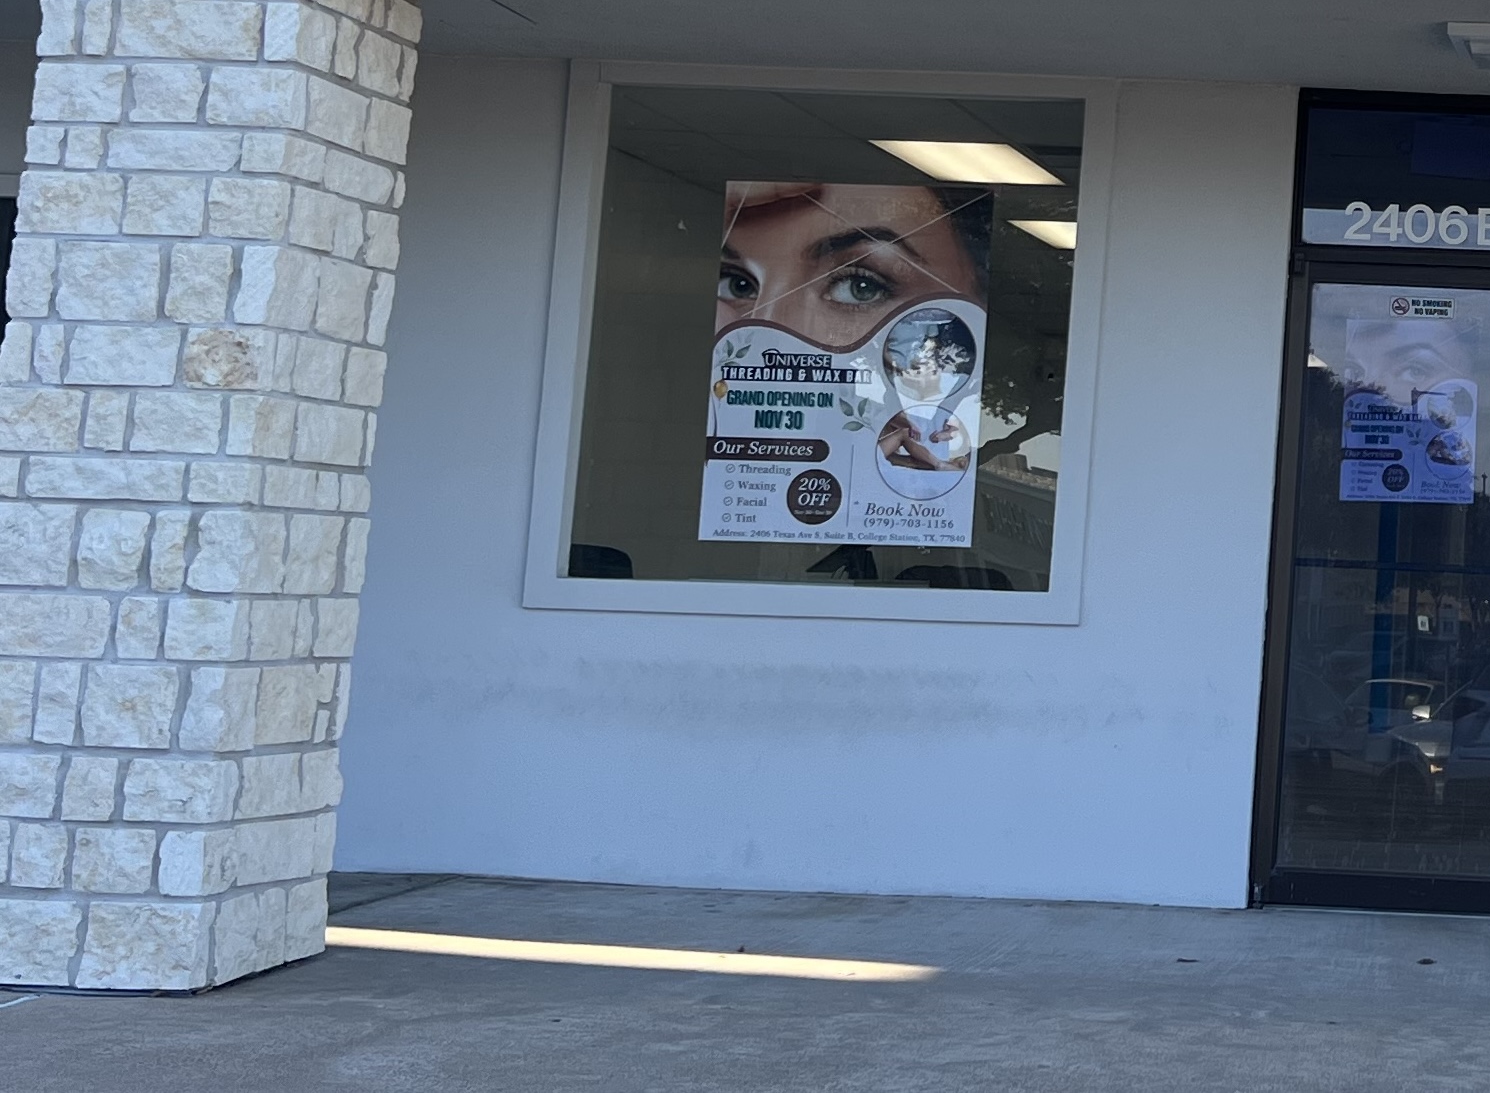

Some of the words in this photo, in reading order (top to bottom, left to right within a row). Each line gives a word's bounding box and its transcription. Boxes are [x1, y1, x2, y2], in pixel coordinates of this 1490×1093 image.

[1411, 299, 1421, 307] NO
[1422, 299, 1452, 308] SMOKING
[1414, 307, 1424, 315] NO
[1424, 308, 1449, 316] VAPING
[765, 354, 831, 368] UNIVERSE
[721, 367, 792, 381] THREADING
[798, 370, 807, 381] &
[812, 370, 841, 382] WAX
[846, 370, 872, 384] BAR
[727, 389, 765, 406] GRAND
[766, 391, 817, 407] OPENING
[817, 392, 834, 408] ON
[754, 409, 784, 429] NOV
[785, 410, 804, 430] 30
[713, 439, 745, 455] Our
[747, 441, 814, 457] Services
[738, 464, 792, 477] Threading
[738, 480, 777, 493] Waxing
[798, 477, 831, 492] 20%
[736, 496, 768, 507] Facial
[798, 492, 832, 507] OFF
[864, 502, 905, 517] Book
[907, 503, 945, 518] Now
[735, 512, 757, 523] Tint
[863, 517, 955, 530] (979)-703-1156
